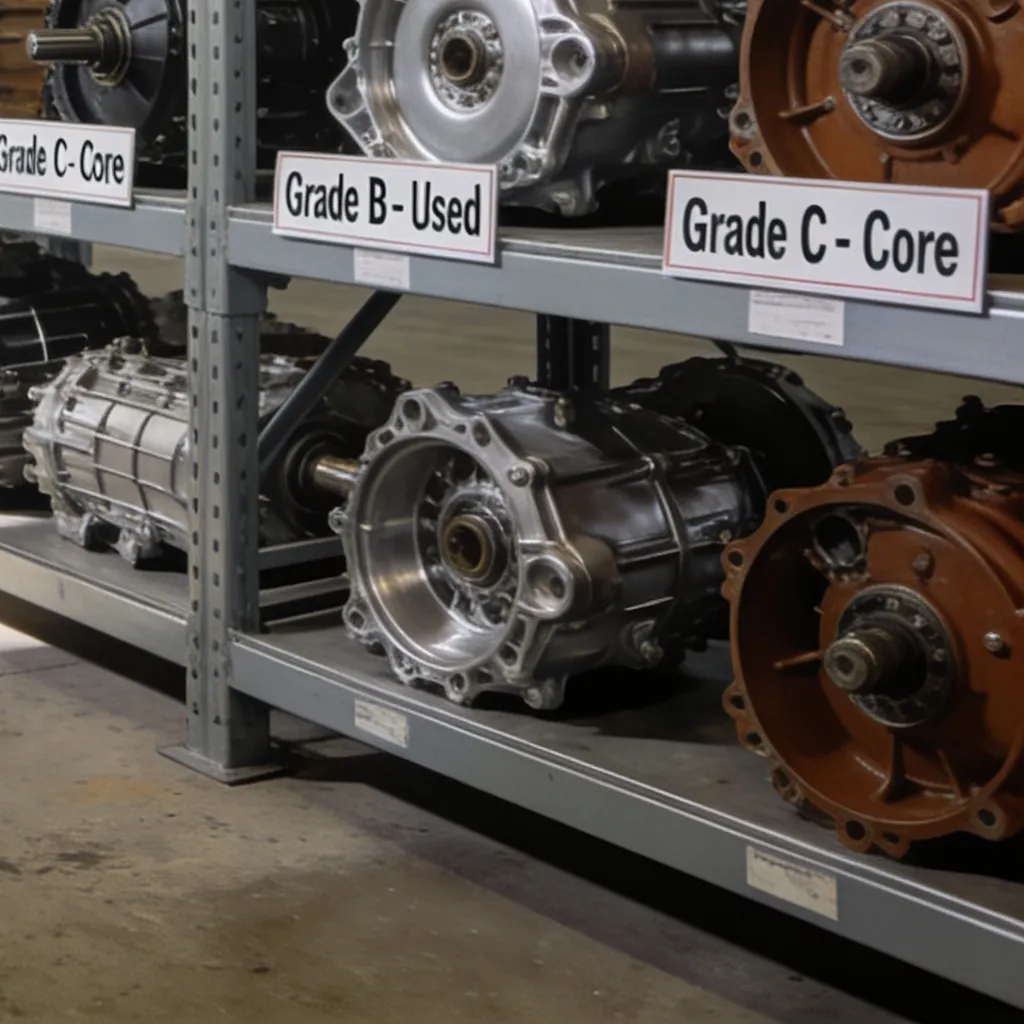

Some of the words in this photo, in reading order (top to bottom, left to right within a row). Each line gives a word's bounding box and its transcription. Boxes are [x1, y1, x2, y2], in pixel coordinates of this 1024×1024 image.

[79, 139, 125, 185] Core
[285, 171, 360, 224] Grade
[369, 176, 387, 225] B
[412, 179, 482, 237] Used
[682, 196, 787, 260] Grade
[800, 204, 827, 264] C
[863, 209, 960, 277] Core
